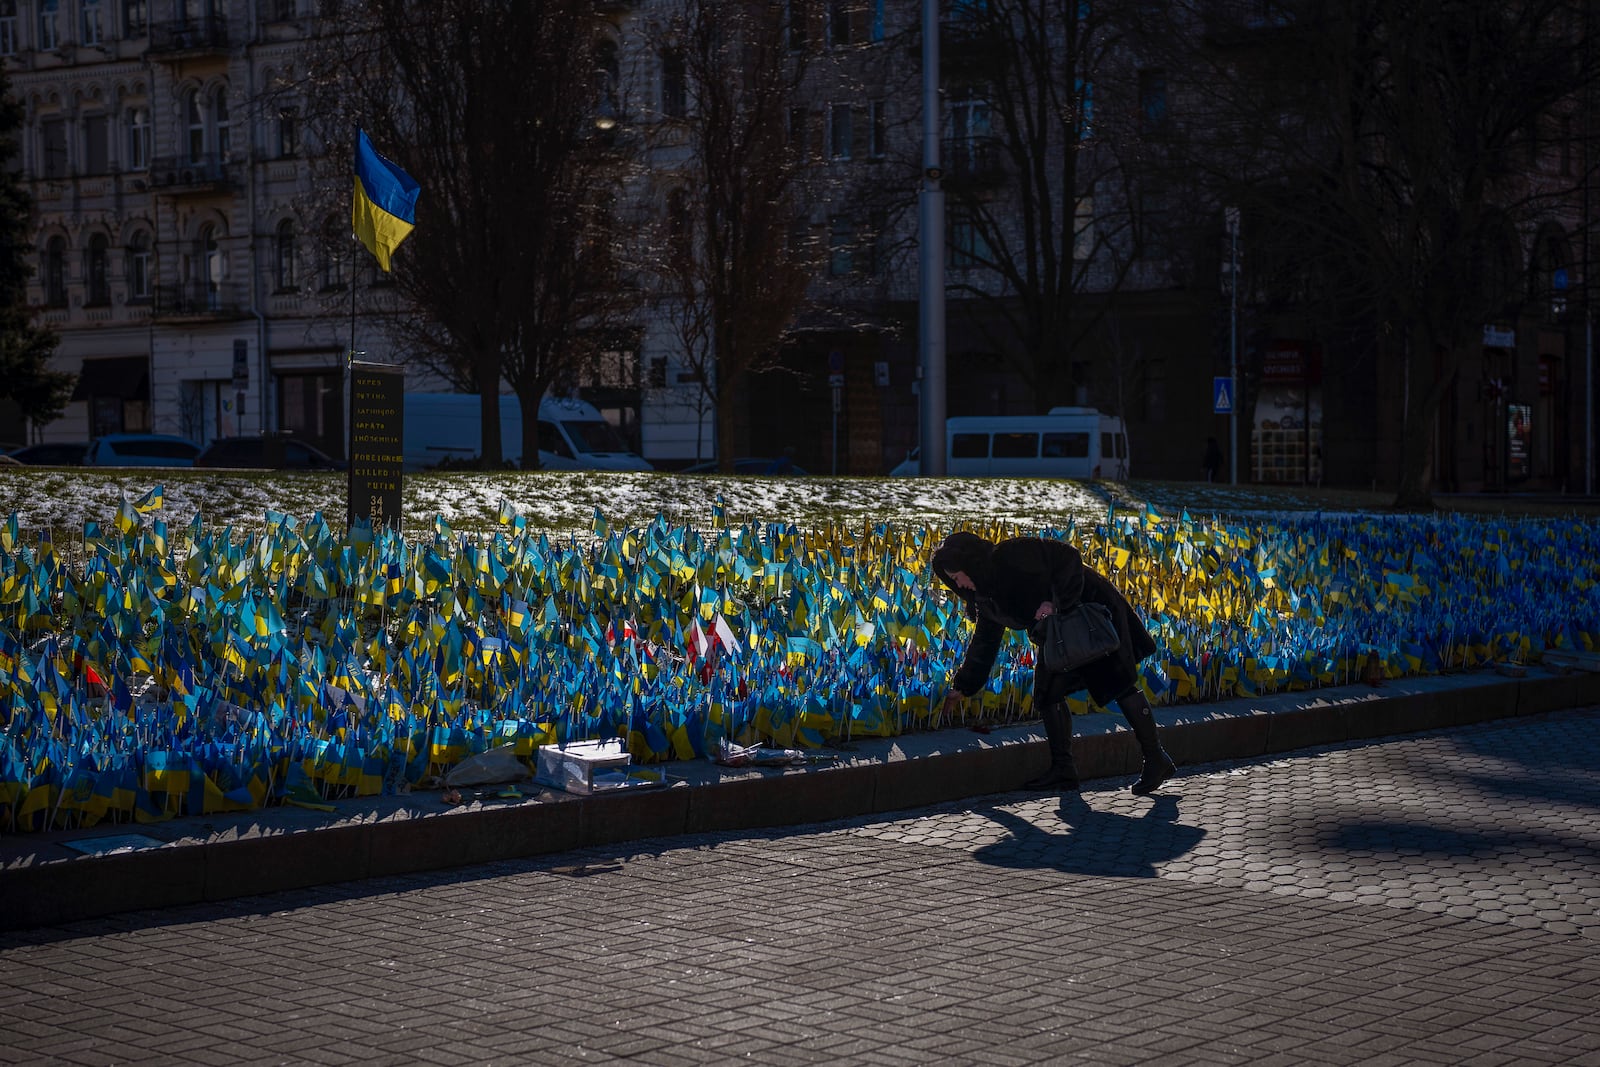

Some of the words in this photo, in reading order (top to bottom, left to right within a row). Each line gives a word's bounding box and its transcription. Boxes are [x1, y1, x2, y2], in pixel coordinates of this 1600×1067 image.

[367, 482, 395, 490] PUTIN
[370, 495, 384, 506] 34
[370, 505, 384, 517] 54
